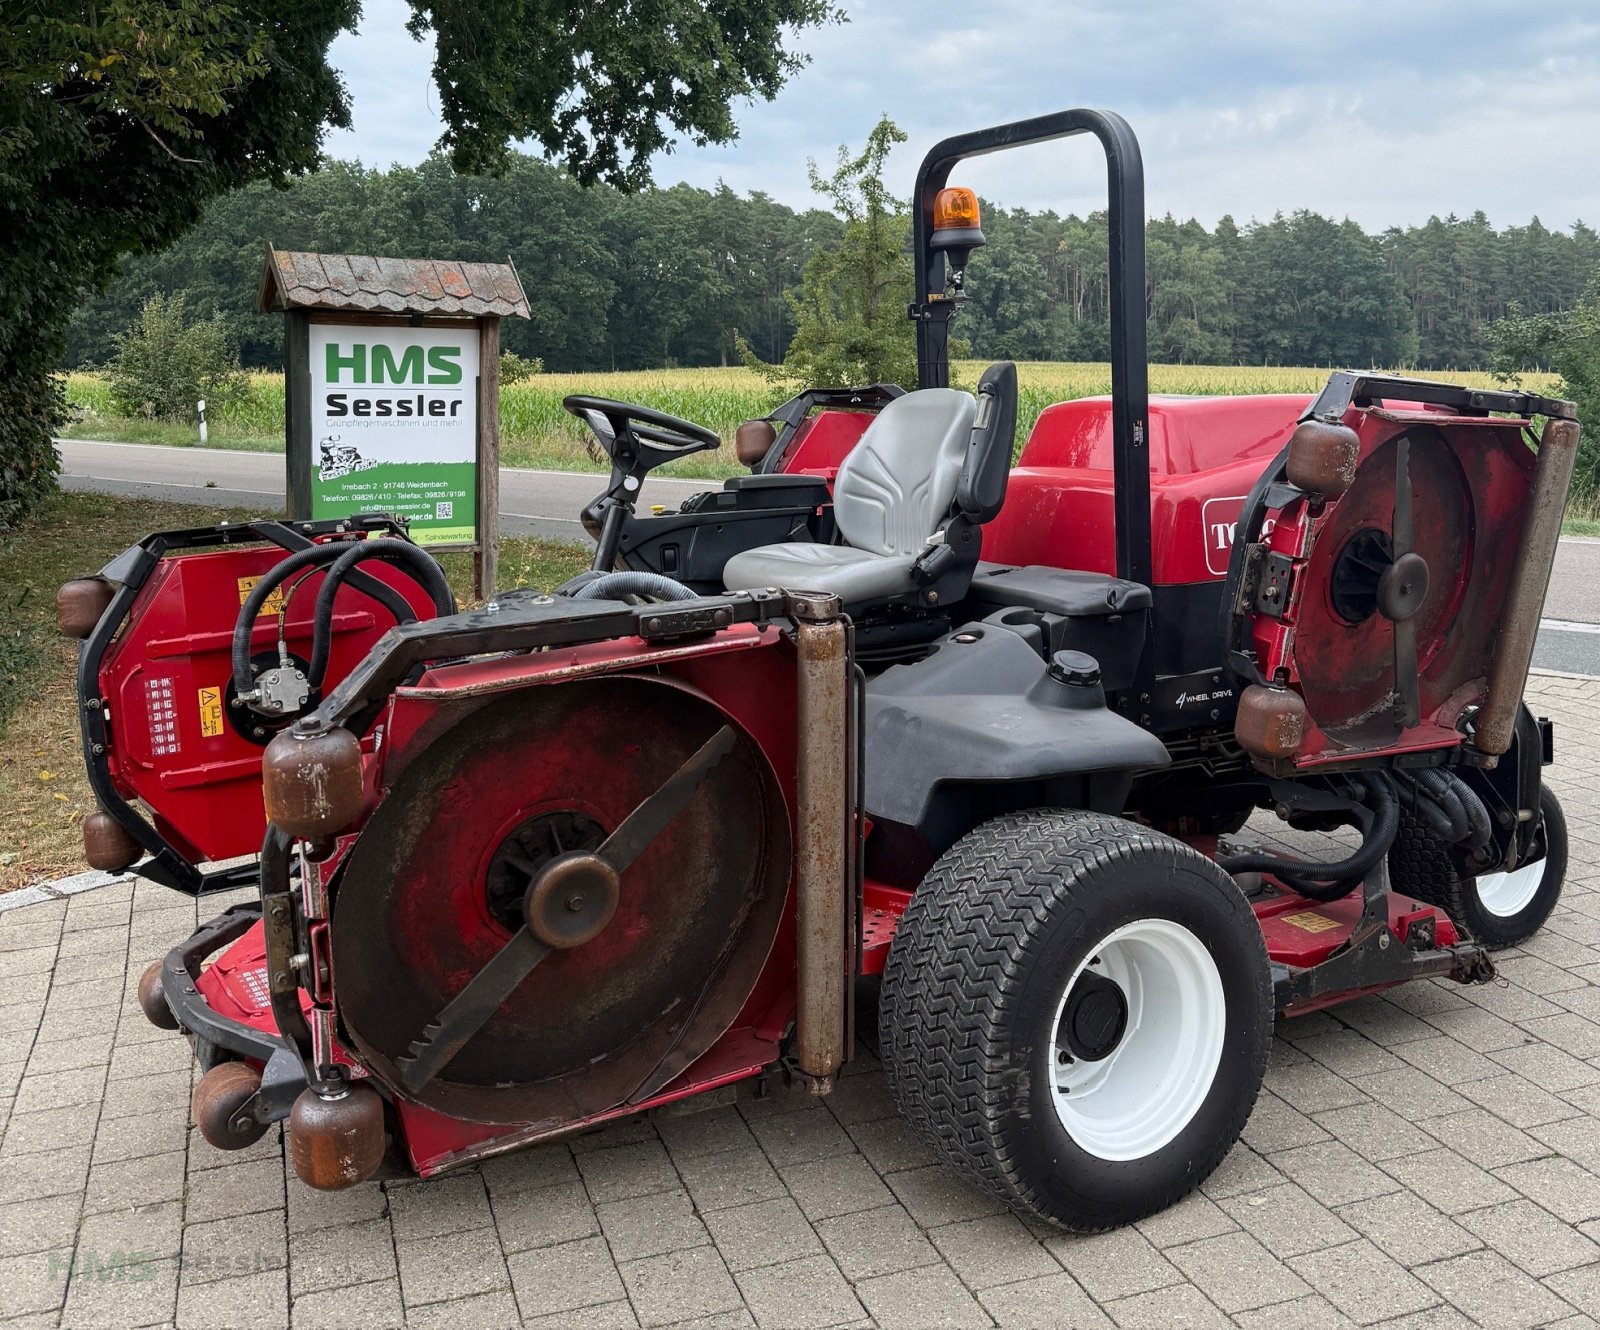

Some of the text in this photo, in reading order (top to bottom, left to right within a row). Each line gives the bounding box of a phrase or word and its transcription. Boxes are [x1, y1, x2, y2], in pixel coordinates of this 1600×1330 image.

[325, 343, 463, 385] HMS
[326, 394, 463, 417] Sessler
[326, 418, 420, 428] Grünpflegemaschinen
[422, 419, 438, 427] und
[373, 482, 378, 490] 2
[406, 480, 448, 489] Weidenbach
[322, 494, 350, 502] Telefon:
[424, 533, 473, 541] Spindelwartung
[1176, 689, 1233, 709] 4 WHEEL DRIVE
